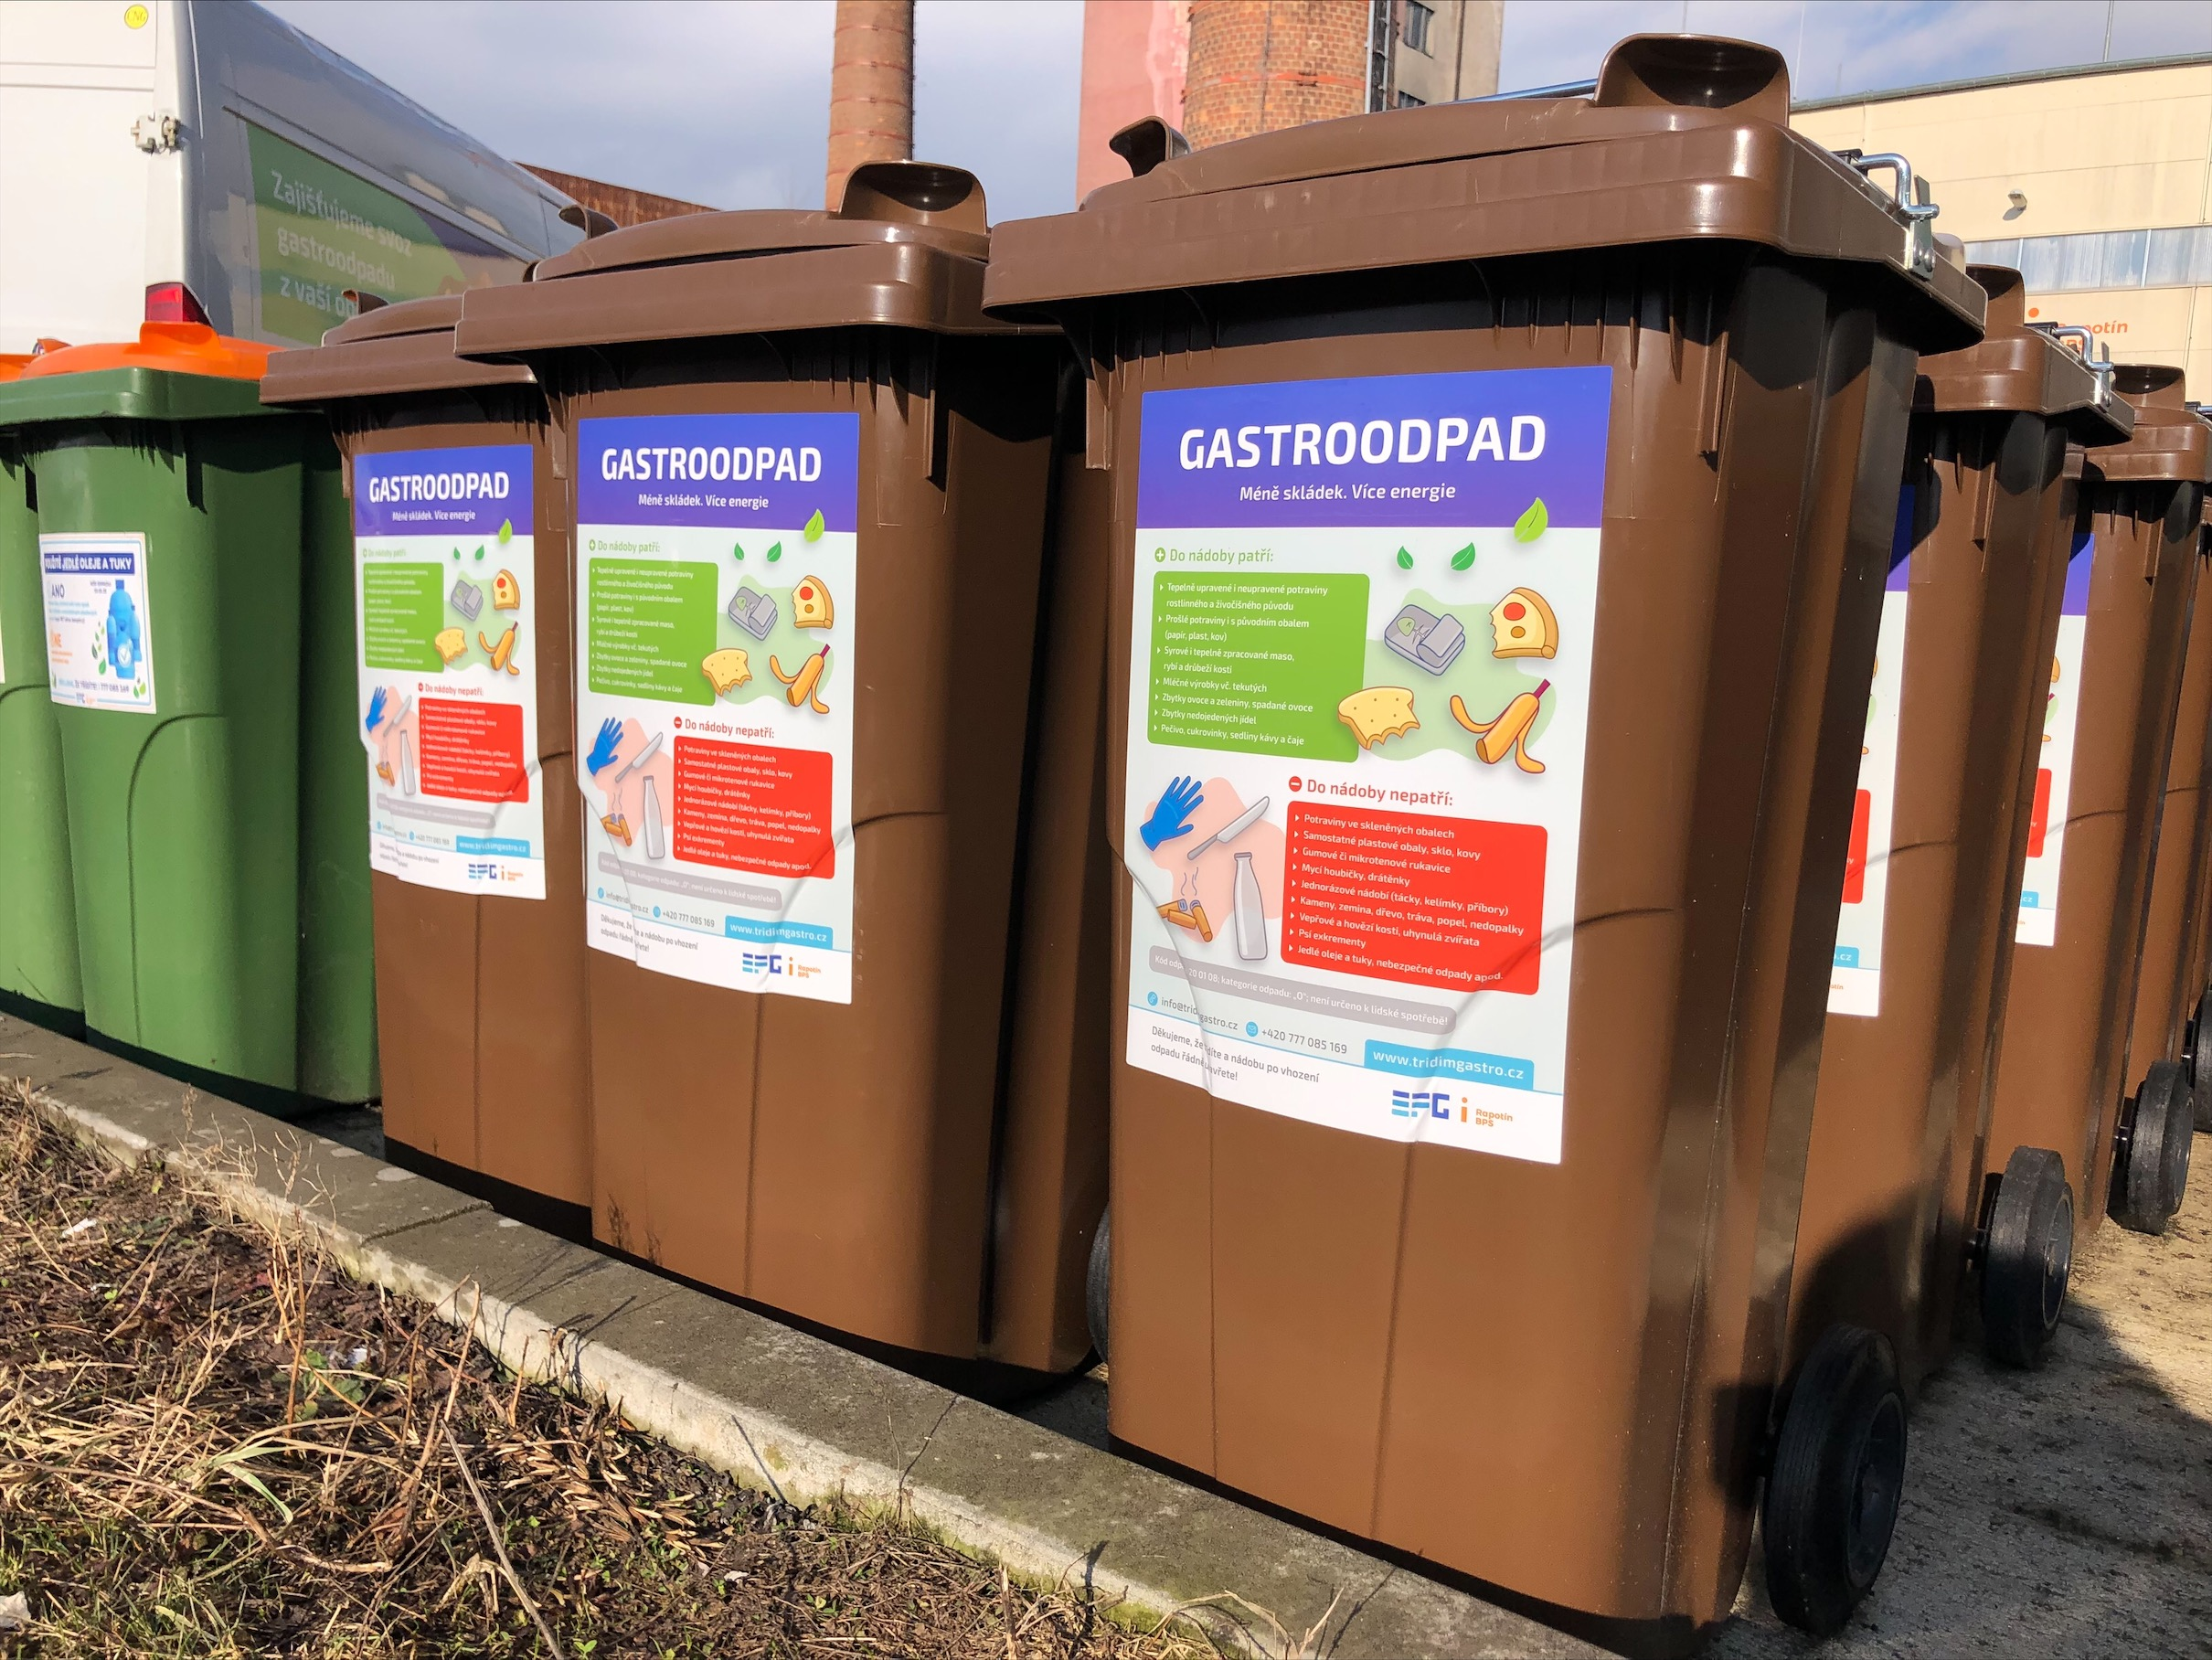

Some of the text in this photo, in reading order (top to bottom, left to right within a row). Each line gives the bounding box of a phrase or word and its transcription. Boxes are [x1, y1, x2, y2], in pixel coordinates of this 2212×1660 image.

[271, 169, 411, 256] Zajišťujeme svoz
[277, 228, 395, 291] gastroodpadu
[280, 276, 291, 297] z
[294, 282, 331, 312] vaší
[1179, 415, 1545, 471] GASTROODPAD
[601, 447, 822, 482] GASTROODPAD
[369, 471, 509, 503] GASTROODPAD
[1240, 483, 1455, 501] Méně skládek. Více energie
[638, 494, 769, 510] Méně skládek. Více energie
[450, 510, 476, 522] energie
[598, 540, 607, 551] Do
[1170, 548, 1272, 564] Do nádoby patří:
[80, 558, 132, 570] OLEJE TUKY
[1167, 582, 1328, 596] Tepelně upravené neupravené potraviny
[1166, 599, 1208, 608] rostlinného
[1216, 600, 1261, 609] živočišného
[1261, 601, 1293, 612] původu
[1165, 614, 1188, 623] Prošlé
[1188, 616, 1226, 626] potraviny
[1236, 616, 1277, 627] původním
[1278, 618, 1309, 627] obalem
[1164, 630, 1227, 642] (papír, plast, kov)
[1164, 645, 1188, 655] Syrové
[1192, 648, 1221, 657] tepelně
[1223, 651, 1268, 659] zpracované
[1164, 662, 1177, 671] rybí
[1184, 663, 1212, 672] drůbeží
[1213, 665, 1231, 674] kosti
[1163, 677, 1267, 693] Mléčné výrobky vč. tekutých
[1163, 693, 1186, 704] Zbytky
[1215, 697, 1250, 708] zeleniny,
[1252, 700, 1286, 710] spadané
[1287, 704, 1313, 712] ovoce
[686, 718, 773, 738] Do nádoby nepatří:
[1162, 708, 1256, 725] Zbytky nedojedených jídel
[1161, 724, 1185, 735] Pečivo,
[1186, 727, 1228, 740] cukrovinky,
[1230, 731, 1258, 742] sedliny
[1258, 733, 1279, 744] kávy
[1287, 735, 1303, 746] čaje
[1307, 779, 1452, 805] Do nádoby nepatří:
[1303, 814, 1345, 828] Potraviny
[1360, 821, 1413, 835] skleněných
[1415, 826, 1454, 838] obalech
[1303, 830, 1480, 860] Samostatné plastové obaly, sklo, kovy
[1302, 846, 1451, 873] Gumové či mikrotenové rukavice
[1301, 863, 1409, 887] Mycí houbičky, drátěnky
[1301, 880, 1508, 916] Jednorázové nádobí (tácky, kelímky, příbory)
[1300, 896, 1524, 936] Kameny, zemina, dřevo, tráva, popel, nedopalky
[1298, 929, 1366, 949] Psí exkrementy
[1300, 912, 1335, 925] Vepřové
[1344, 920, 1374, 931] hovězí
[1375, 924, 1400, 936] kosti,
[1403, 929, 1441, 941] uhynulá
[1444, 935, 1479, 946] zvířata
[1298, 945, 1319, 956] Jedlé
[1321, 950, 1343, 961] oleje
[1352, 954, 1374, 966] tuky,
[1376, 959, 1433, 974] nebezpečné
[1435, 968, 1472, 980] odpady
[1474, 972, 1502, 982] apod.
[1154, 955, 1168, 965] Kód
[1188, 969, 1197, 977] 20
[1198, 971, 1207, 980] 01
[1219, 975, 1257, 991] kategorie
[1259, 985, 1291, 997] odpadu:
[1310, 996, 1329, 1005] není
[1331, 1000, 1361, 1011] určeno
[1371, 1005, 1398, 1017] lidské
[1401, 1012, 1450, 1028] spotřebě!
[1262, 1028, 1346, 1054] +420 777 085 169
[1151, 1044, 1204, 1067] odpadu řádně
[1152, 1026, 1192, 1048] Děkujeme,
[1194, 1038, 1204, 1050] že
[1231, 1054, 1264, 1069] nádobu
[1267, 1064, 1278, 1073] po
[1281, 1066, 1319, 1082] vhození
[1373, 1051, 1523, 1079] www.tridimgastro.cz
[1475, 1108, 1514, 1123] Rapotín
